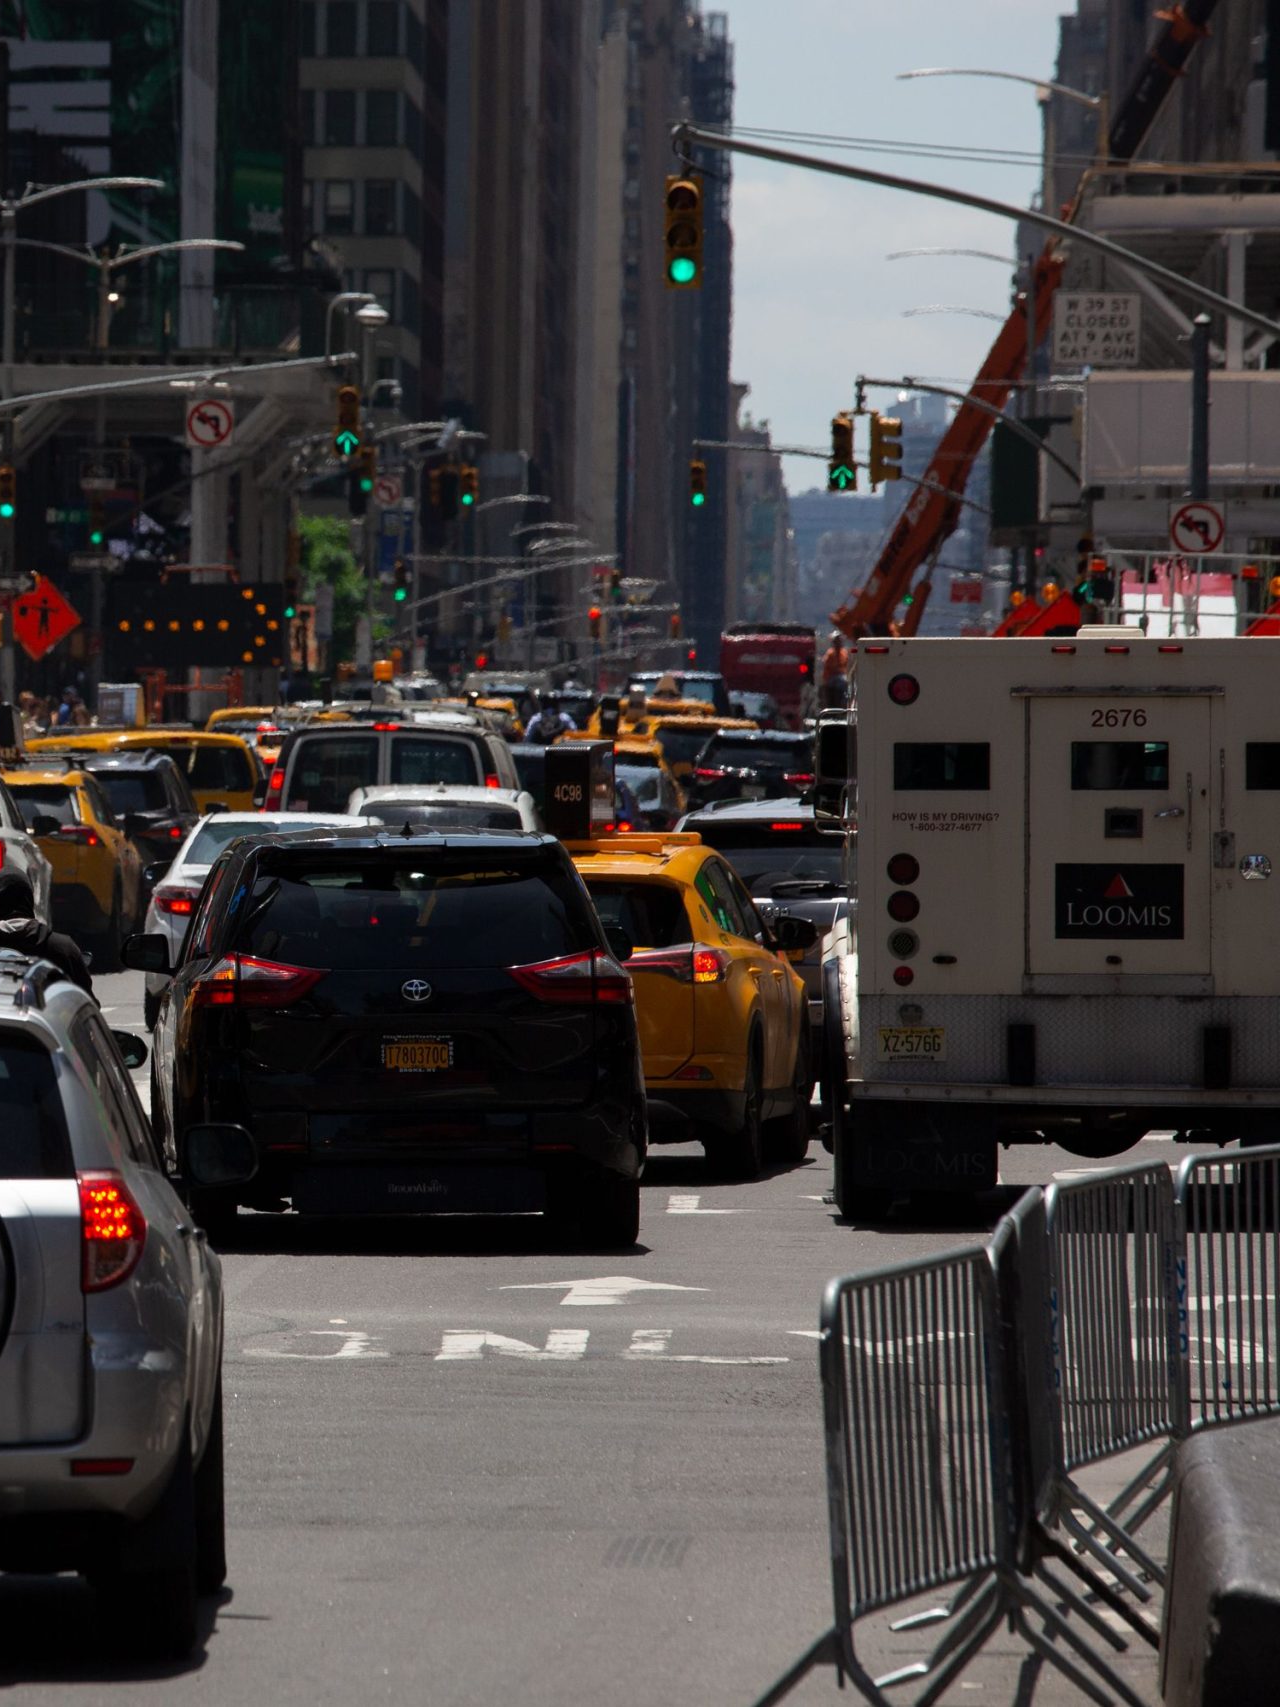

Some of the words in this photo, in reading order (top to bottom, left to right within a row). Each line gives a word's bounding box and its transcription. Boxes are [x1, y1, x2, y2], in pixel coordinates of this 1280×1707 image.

[1111, 298, 1130, 312] ST
[1066, 314, 1129, 328] CLOSED
[1060, 330, 1081, 342] AT
[1102, 330, 1135, 344] AVE
[1091, 709, 1146, 727] 2676
[554, 784, 582, 802] 4C98
[892, 813, 916, 821] HOW
[920, 813, 929, 821] IS
[932, 813, 948, 821] MY
[950, 813, 1000, 821] DRIVING?
[910, 823, 982, 831] 1-800-327-4677
[1067, 902, 1172, 926] LOOMIS
[388, 1046, 447, 1064] T780370C
